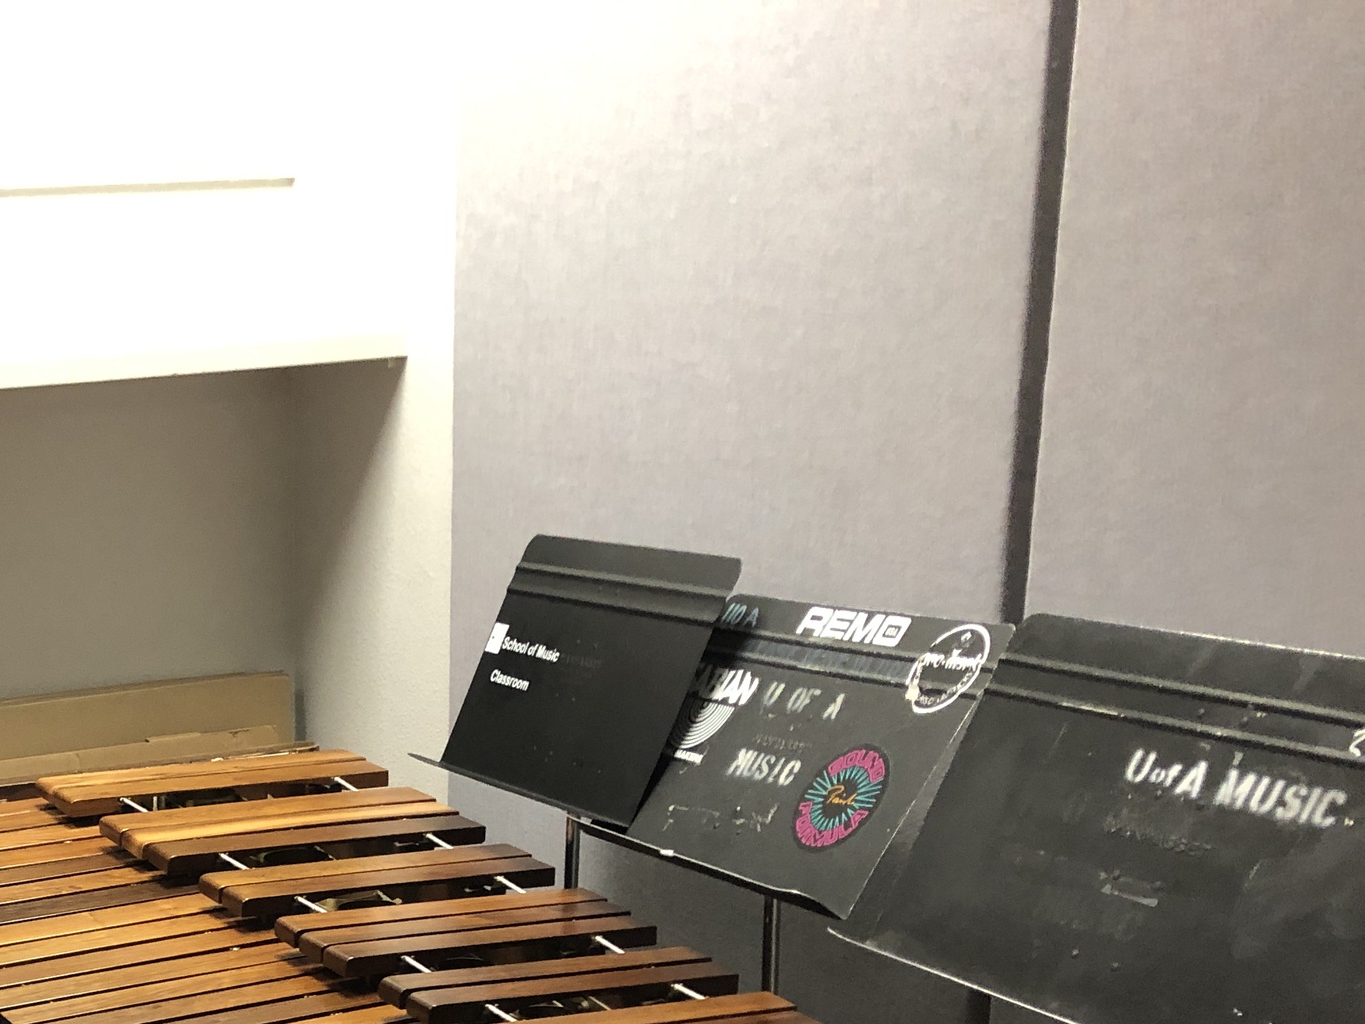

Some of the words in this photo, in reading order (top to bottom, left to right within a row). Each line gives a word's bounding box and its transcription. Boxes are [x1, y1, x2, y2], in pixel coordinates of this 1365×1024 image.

[795, 606, 912, 648] REMO
[502, 636, 531, 655] School
[527, 643, 539, 656] of
[535, 643, 560, 663] Music
[490, 668, 530, 692] Classroom
[760, 681, 786, 708] U
[787, 687, 822, 714] OF
[822, 693, 846, 720] A
[726, 748, 802, 787] MUSIC
[828, 749, 885, 783] SOUND
[1213, 768, 1348, 828] MUSIC
[796, 801, 870, 847] FORMULA
